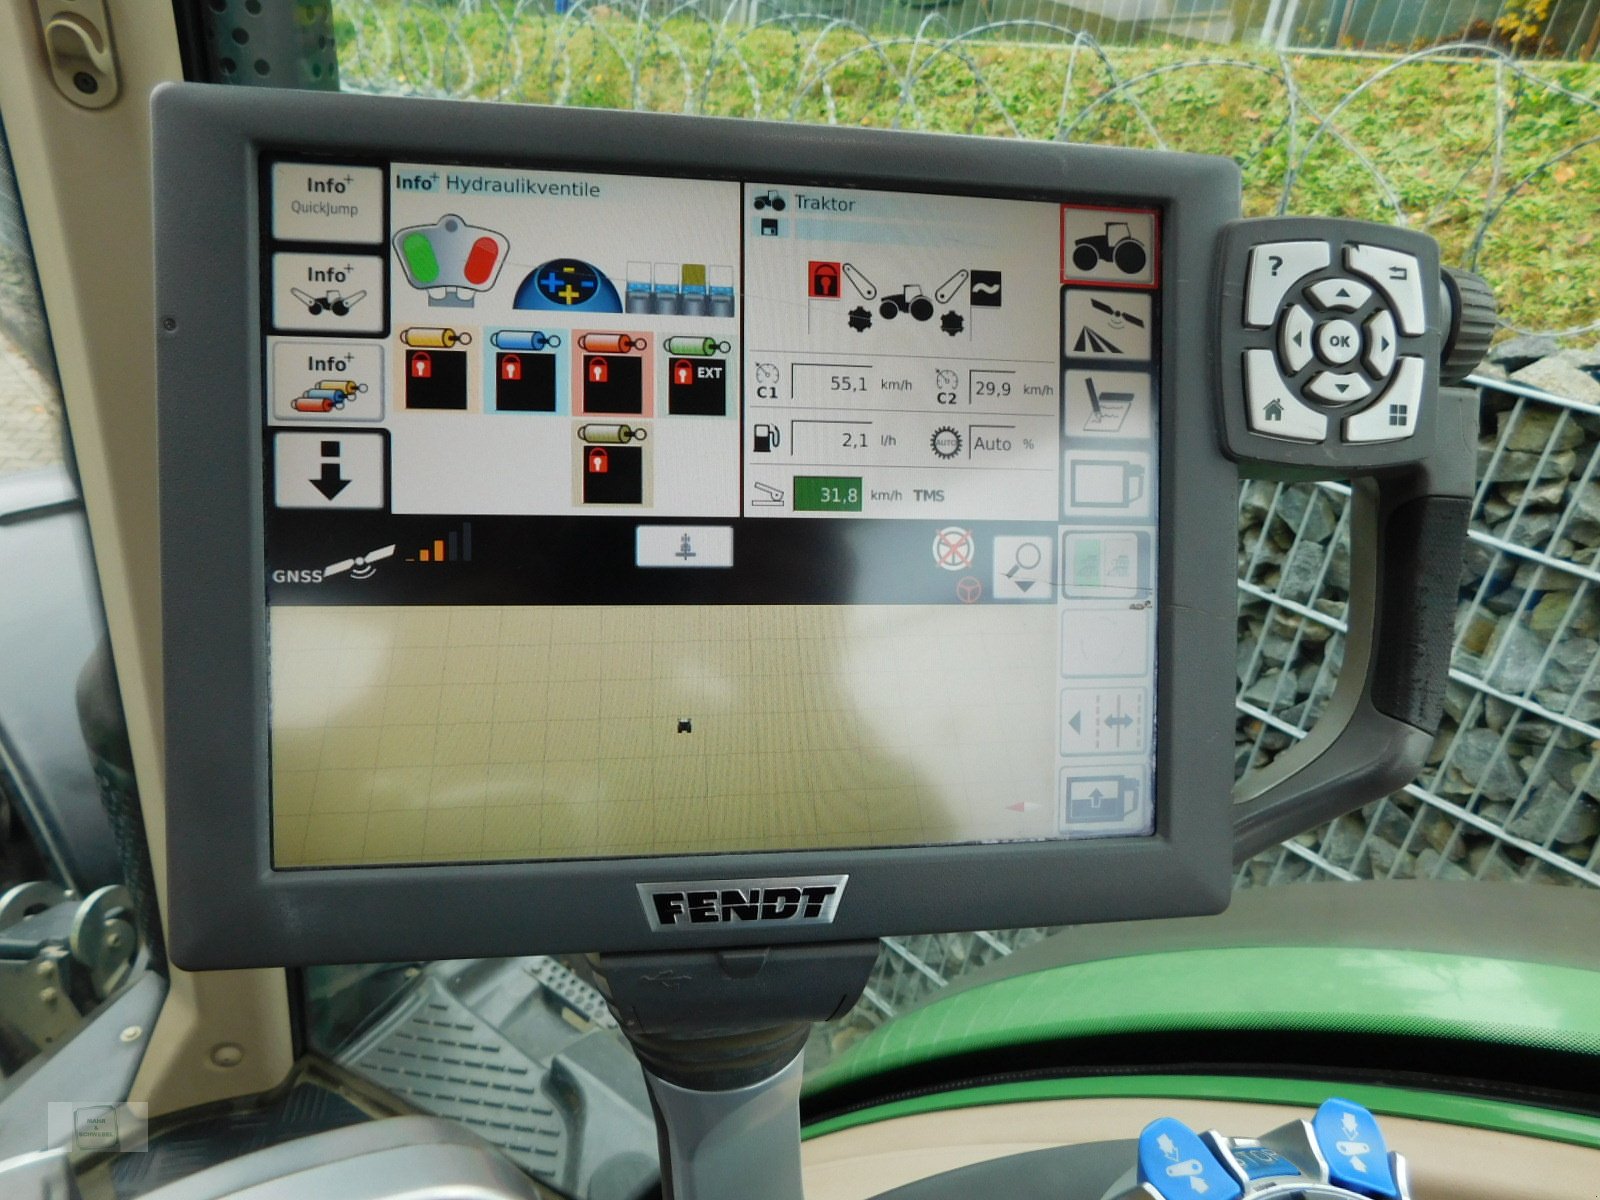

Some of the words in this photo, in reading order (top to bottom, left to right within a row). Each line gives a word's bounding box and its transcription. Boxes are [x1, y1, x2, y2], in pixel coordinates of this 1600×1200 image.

[446, 174, 601, 198] Hydraulikventile
[290, 200, 359, 218] QuickJump
[795, 194, 856, 212] Traktor
[1329, 335, 1350, 348] OK
[698, 366, 723, 379] EXT
[756, 387, 778, 399] C1
[830, 376, 868, 393] 55,1
[881, 379, 913, 392] km/h
[975, 380, 1011, 398] 29,9
[1023, 384, 1054, 397] km/h
[936, 392, 957, 404] C2
[842, 433, 868, 450] 2,1
[974, 435, 1012, 451] Auto
[1023, 438, 1034, 450] %
[821, 486, 857, 504] 31,8
[871, 489, 903, 502] km/h
[913, 489, 945, 502] TMS
[272, 570, 323, 584] GNSS
[652, 886, 837, 924] FENDT
